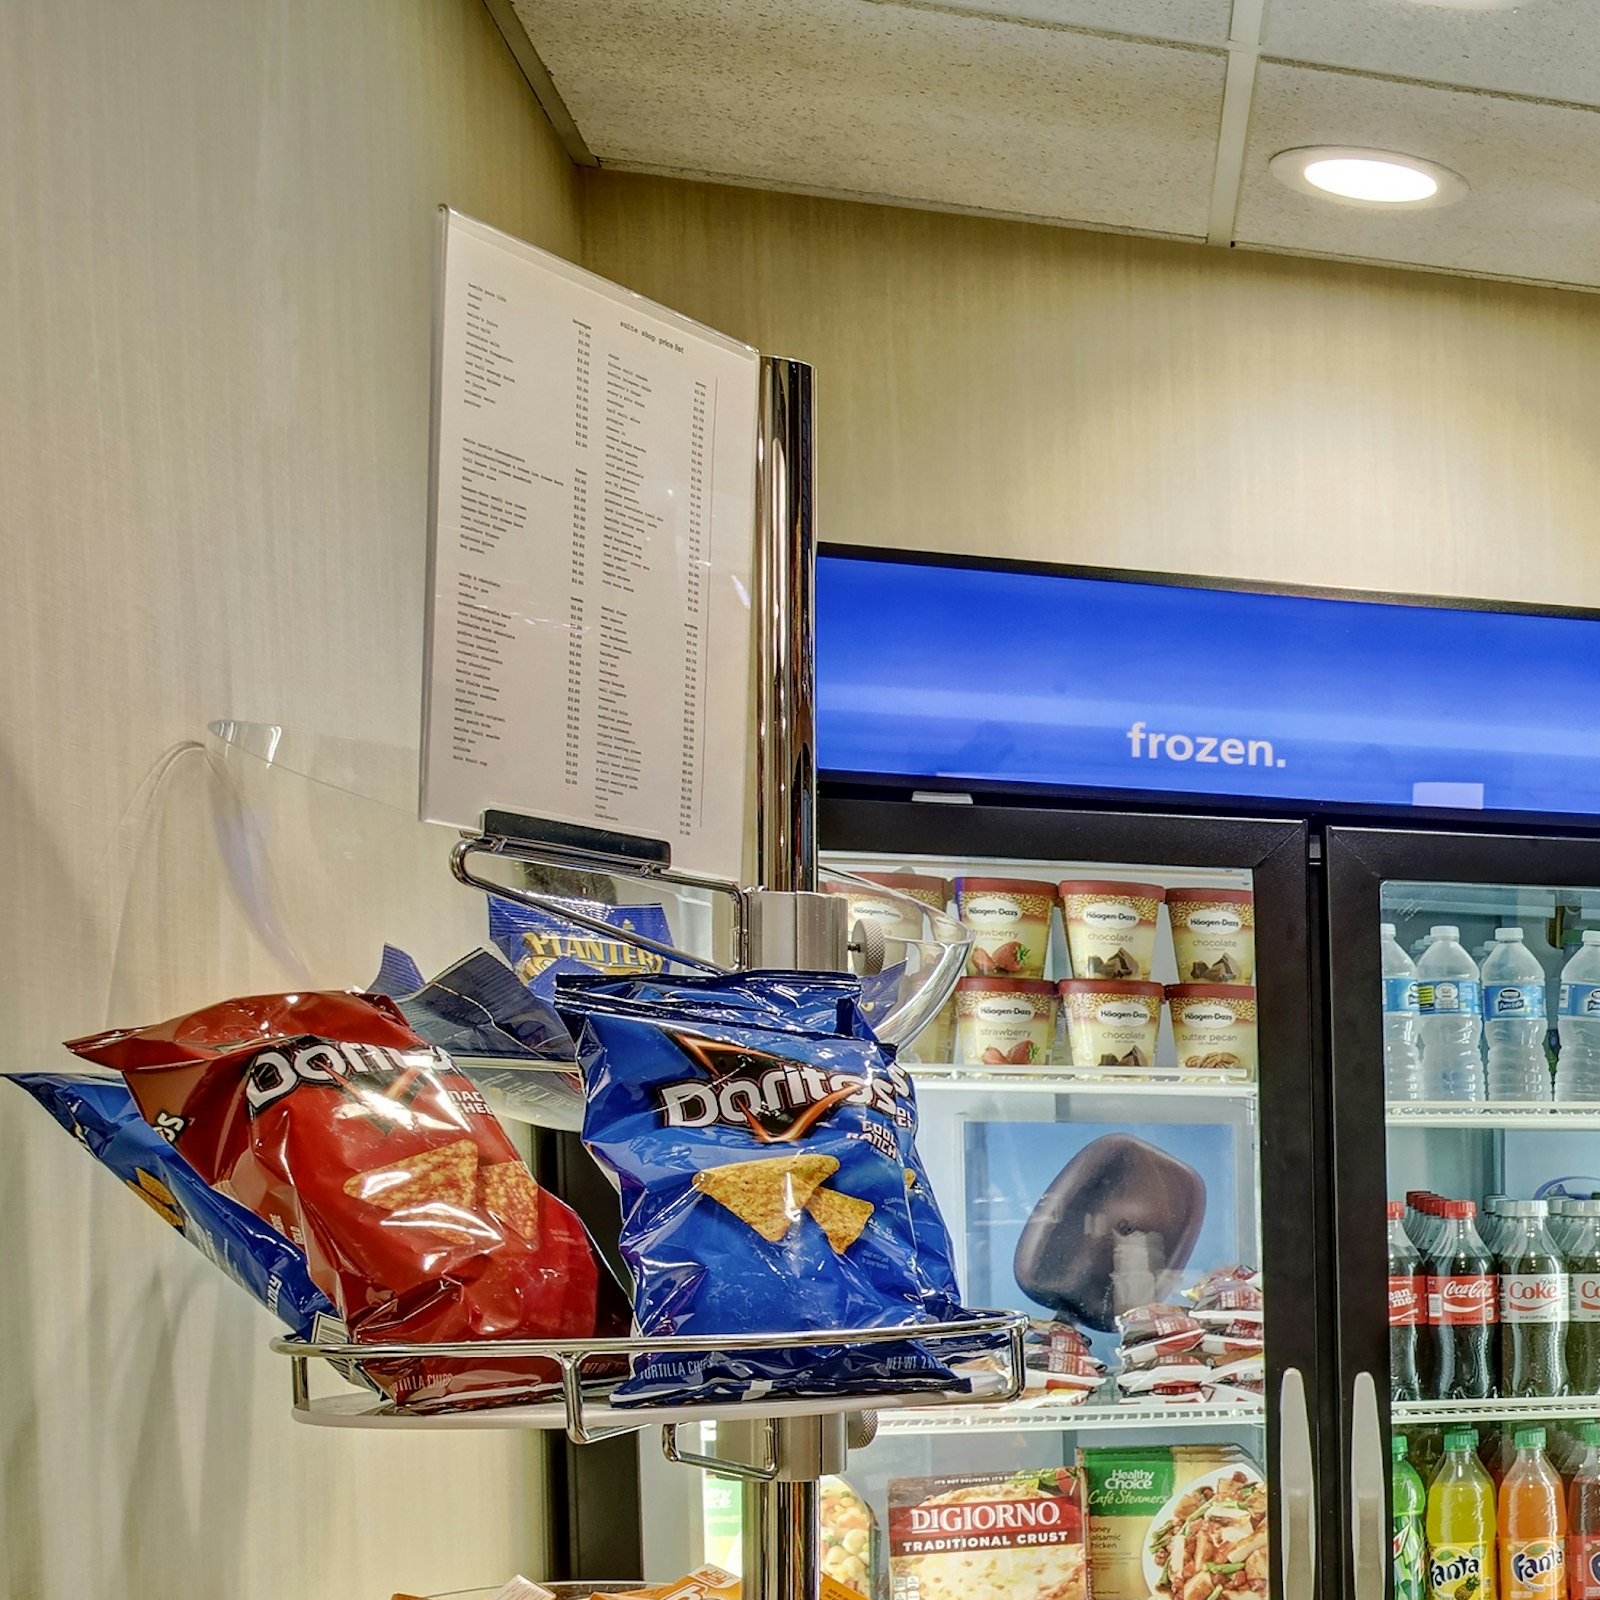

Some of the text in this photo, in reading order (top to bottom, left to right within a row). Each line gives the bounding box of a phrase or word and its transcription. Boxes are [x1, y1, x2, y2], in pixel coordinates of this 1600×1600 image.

[641, 330, 656, 342] shop
[659, 337, 673, 350] price
[1127, 722, 1287, 769] frozen.
[1088, 932, 1135, 943] chocolate
[1192, 938, 1237, 948] chocolate
[980, 1027, 1032, 1039] strawberry
[1182, 1032, 1238, 1044] butter pecan
[660, 1064, 897, 1128] Doritos
[1509, 1281, 1558, 1302] Coke
[1104, 1476, 1152, 1490] Choice
[1112, 1469, 1155, 1482] Healthy
[1116, 1490, 1168, 1505] Steamers
[903, 1531, 1069, 1552] TRADITIONAL CRUST
[1430, 1556, 1480, 1589] Fanta
[1512, 1549, 1564, 1583] Fanta
